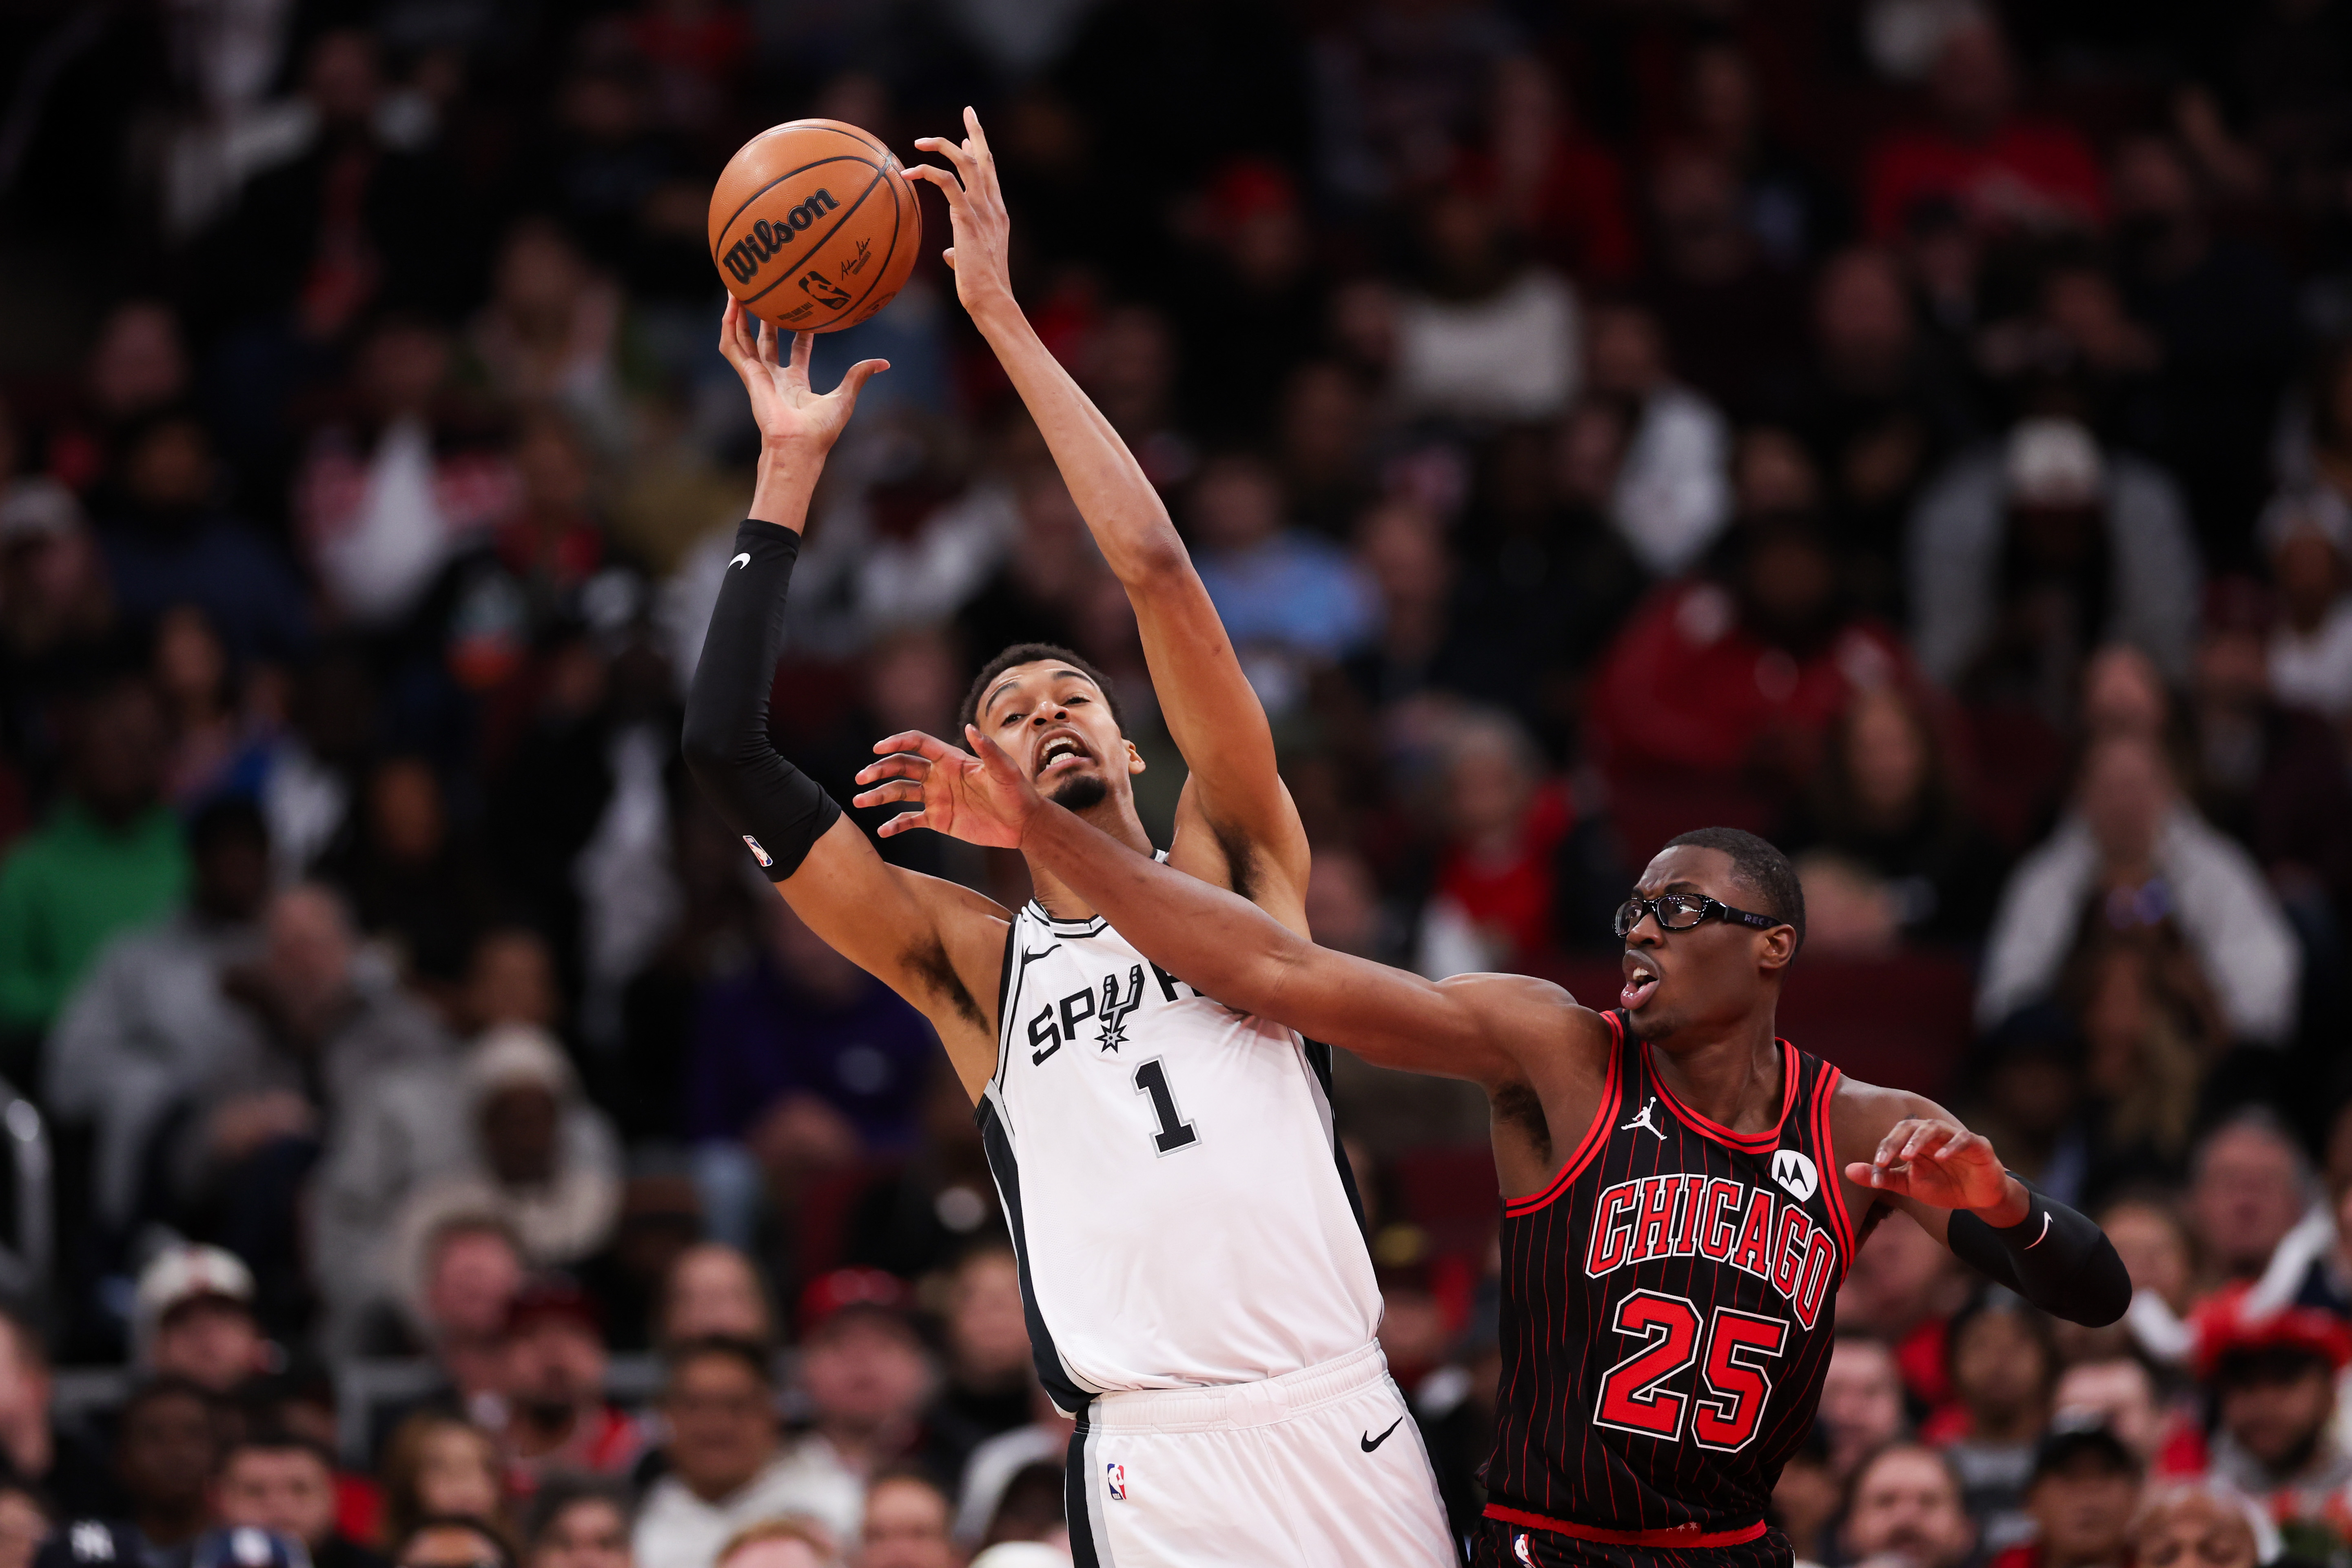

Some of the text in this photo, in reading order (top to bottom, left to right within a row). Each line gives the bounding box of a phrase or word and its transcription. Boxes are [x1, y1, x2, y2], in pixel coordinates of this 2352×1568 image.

[722, 188, 840, 285] Wilson
[1745, 914, 1765, 925] REC
[1028, 960, 1206, 1067] SPU
[1130, 1054, 1202, 1158] 1
[1585, 1173, 1836, 1331] CHICAGO
[1593, 1289, 1790, 1453] 25
